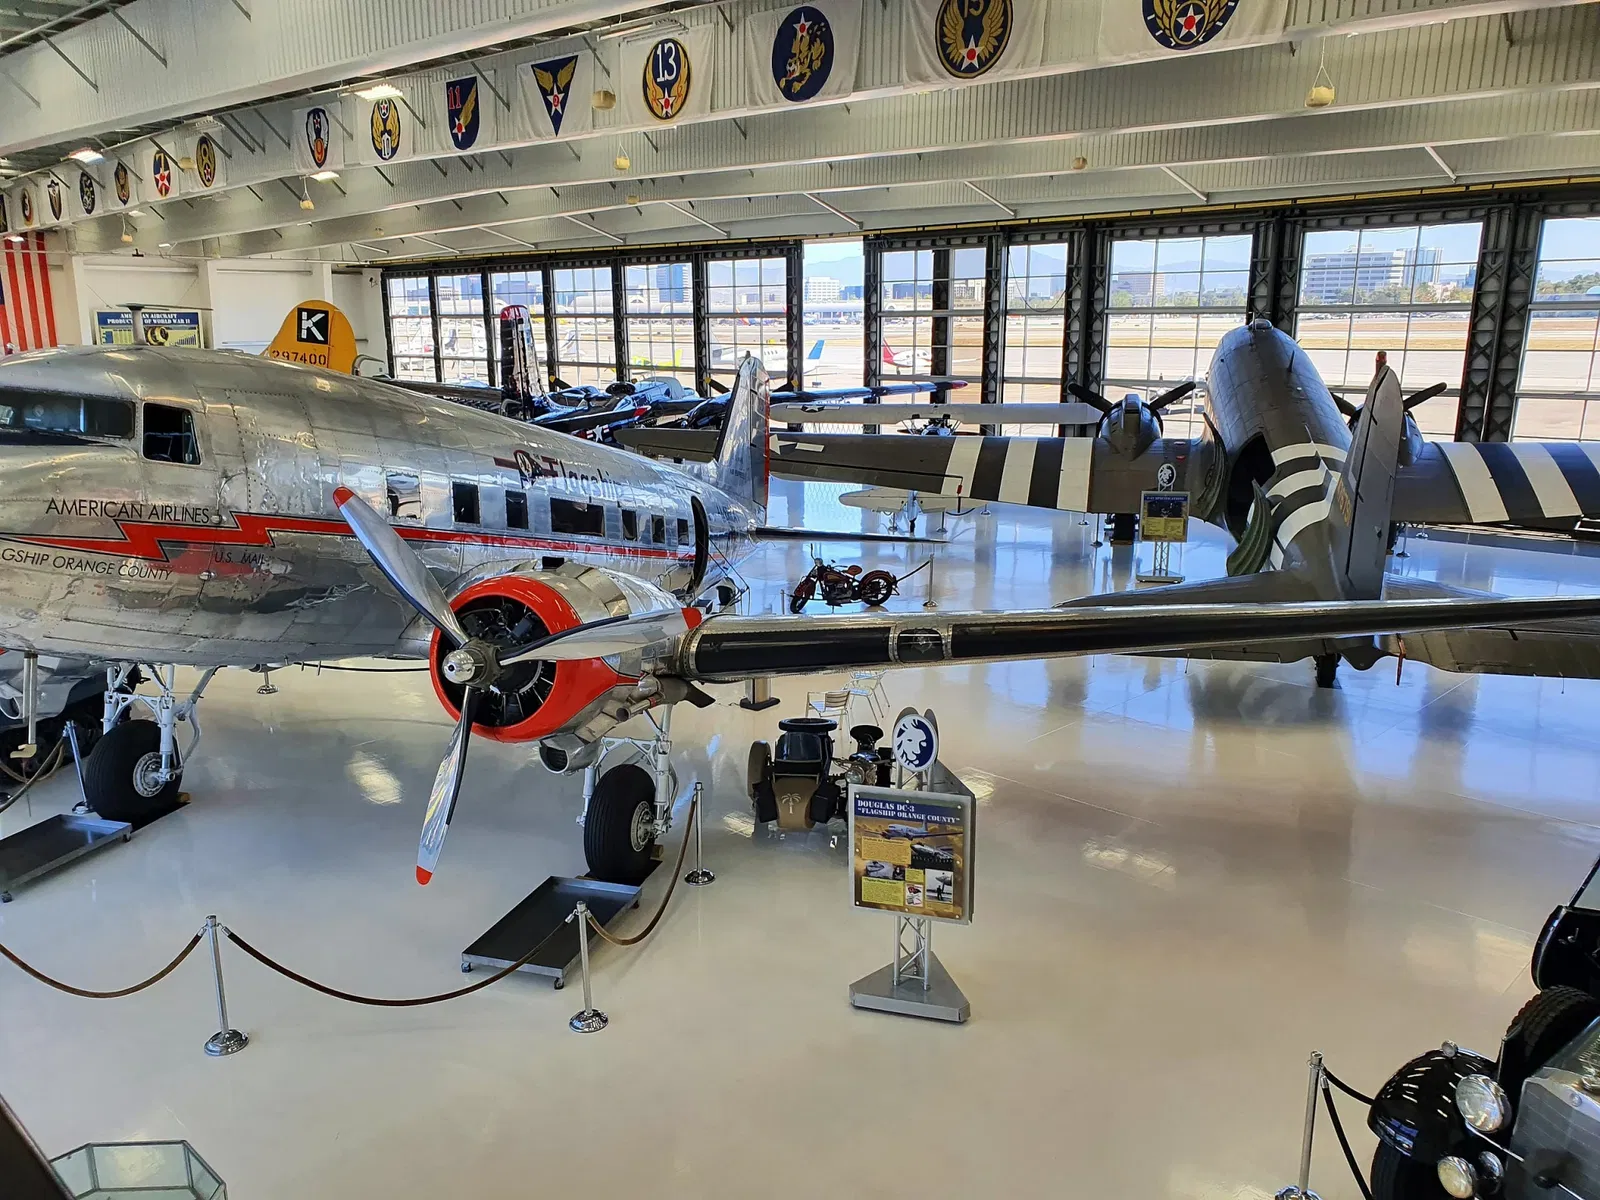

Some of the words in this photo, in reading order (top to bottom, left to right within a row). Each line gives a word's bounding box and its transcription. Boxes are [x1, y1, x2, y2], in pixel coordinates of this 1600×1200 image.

[656, 41, 677, 82] 13
[448, 85, 462, 110] 11
[301, 311, 326, 341] K
[45, 496, 143, 519] AMERICAN
[148, 504, 210, 524] AIRLINES
[0, 547, 49, 566] GSHIP
[52, 555, 116, 575] ORANGE
[117, 564, 173, 581] COUNTY
[214, 551, 233, 563] U.S.
[240, 552, 265, 564] MAIL
[857, 799, 895, 811] DOUGLAS
[896, 804, 915, 813] DC-3
[897, 811, 927, 820] ORANGE
